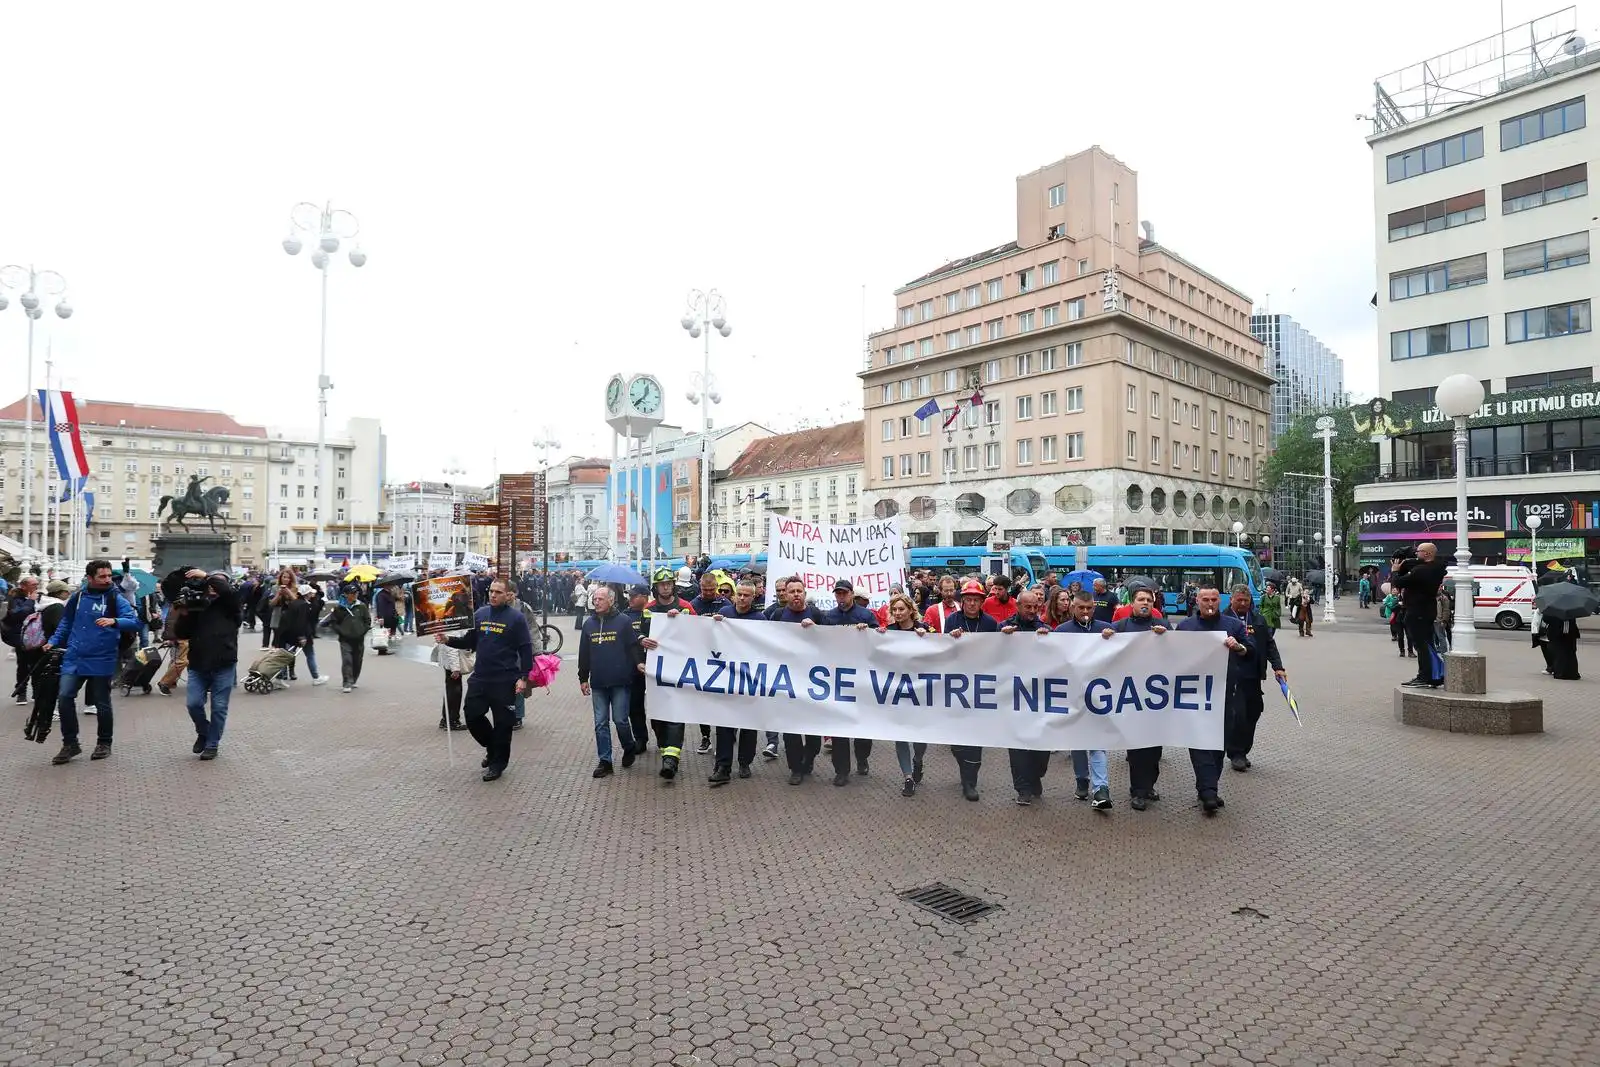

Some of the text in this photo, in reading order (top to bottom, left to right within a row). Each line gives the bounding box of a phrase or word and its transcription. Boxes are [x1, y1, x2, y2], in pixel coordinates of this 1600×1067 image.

[1496, 402, 1507, 415] U
[1512, 396, 1564, 414] RITMU
[1364, 510, 1398, 524] biraš
[777, 518, 896, 543] VATRA NAM IPAK
[779, 541, 895, 566] NIJE NAJVEĆI
[656, 651, 1213, 715] LAŽIMA SE VATRE NE GASE!
